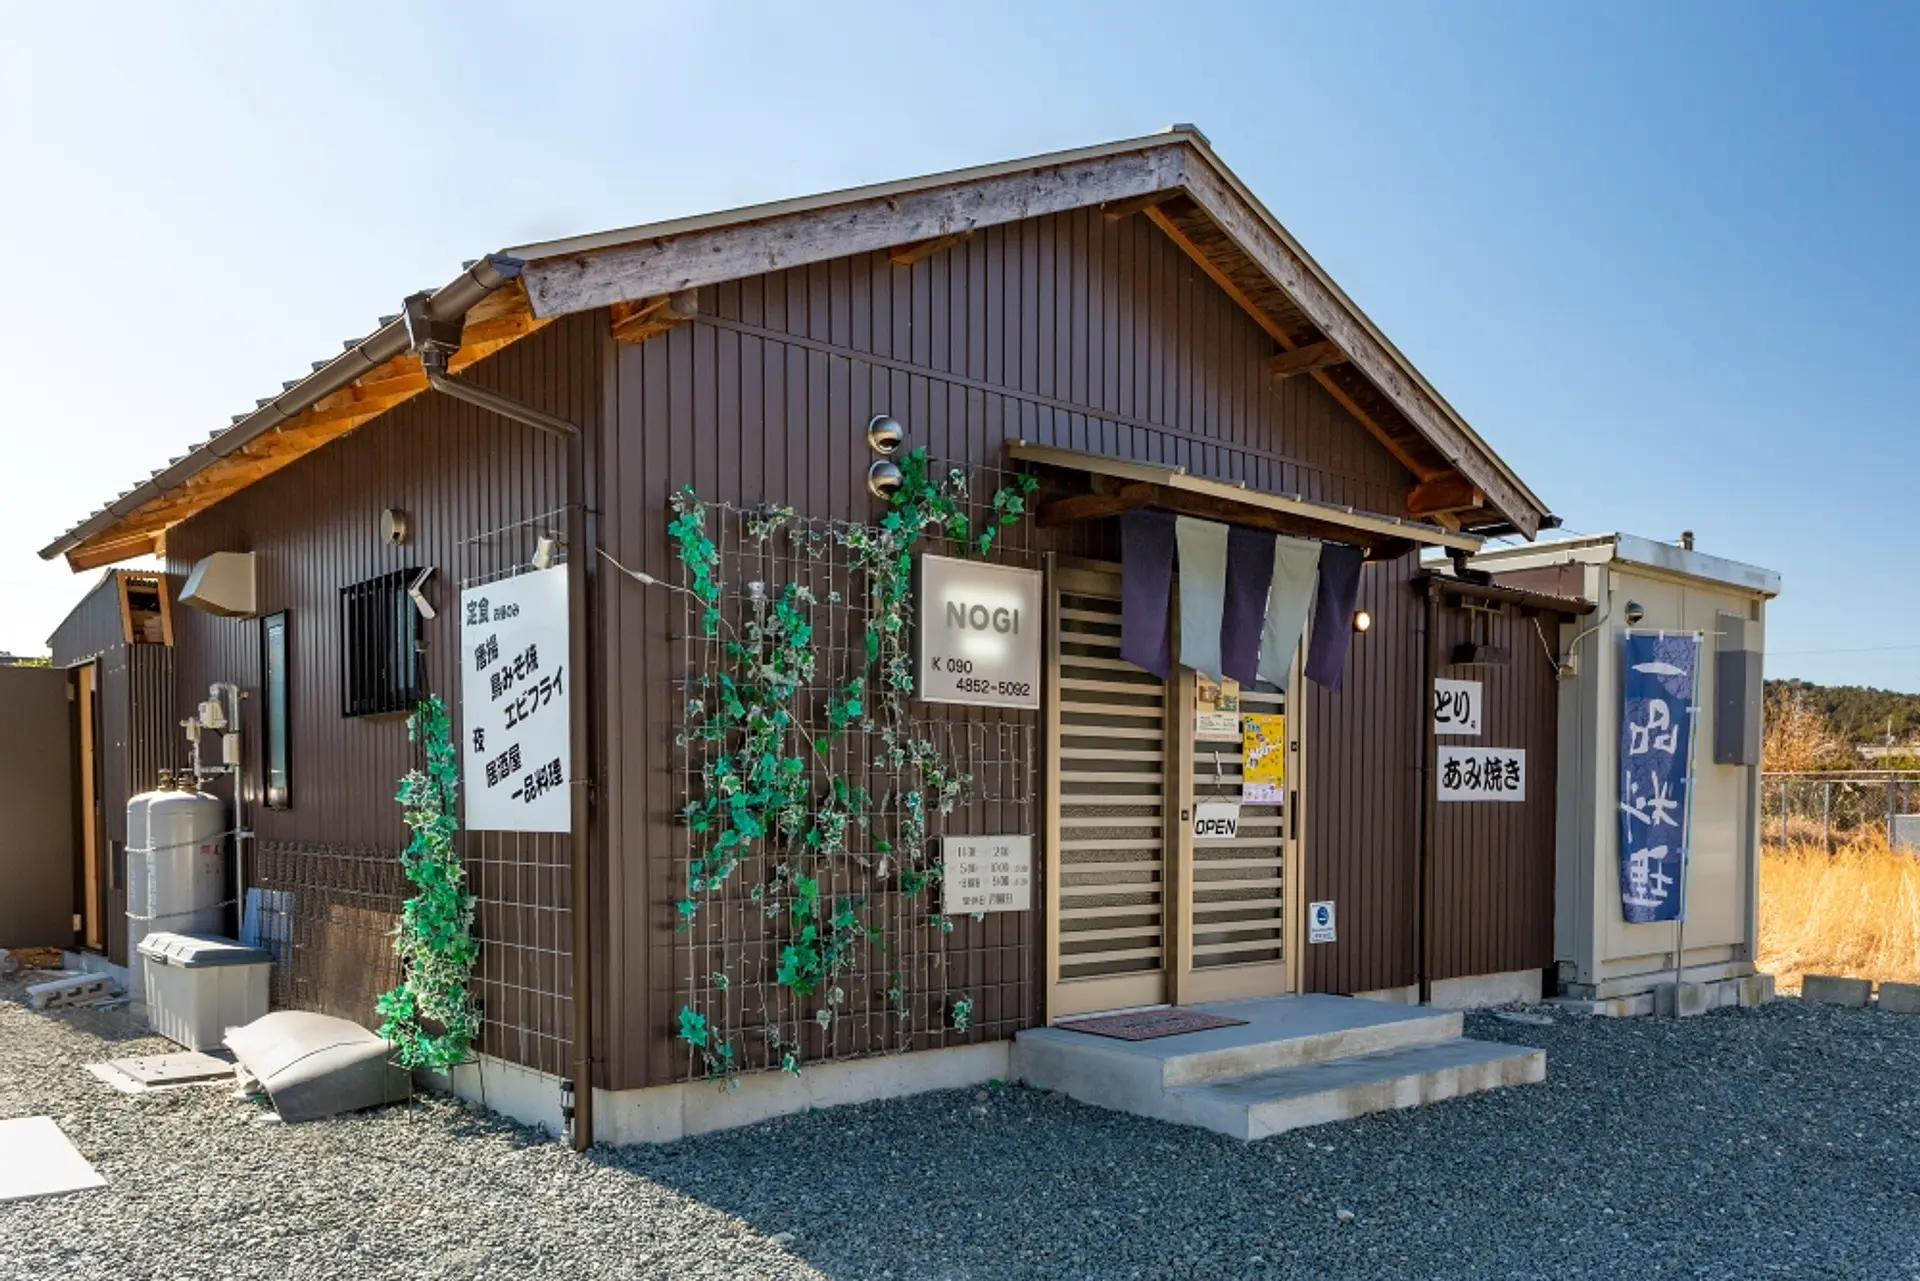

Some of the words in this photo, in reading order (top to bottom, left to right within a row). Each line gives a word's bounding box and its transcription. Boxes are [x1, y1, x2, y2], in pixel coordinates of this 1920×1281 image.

[467, 597, 489, 627] 定食
[946, 600, 1019, 635] NOGI
[947, 659, 972, 674] 090
[504, 665, 563, 730] エビフライ
[486, 742, 522, 788] 居酒屋
[511, 757, 563, 803] 一品料理
[1443, 756, 1520, 791] あみ焼き
[1195, 819, 1236, 835] OPEN
